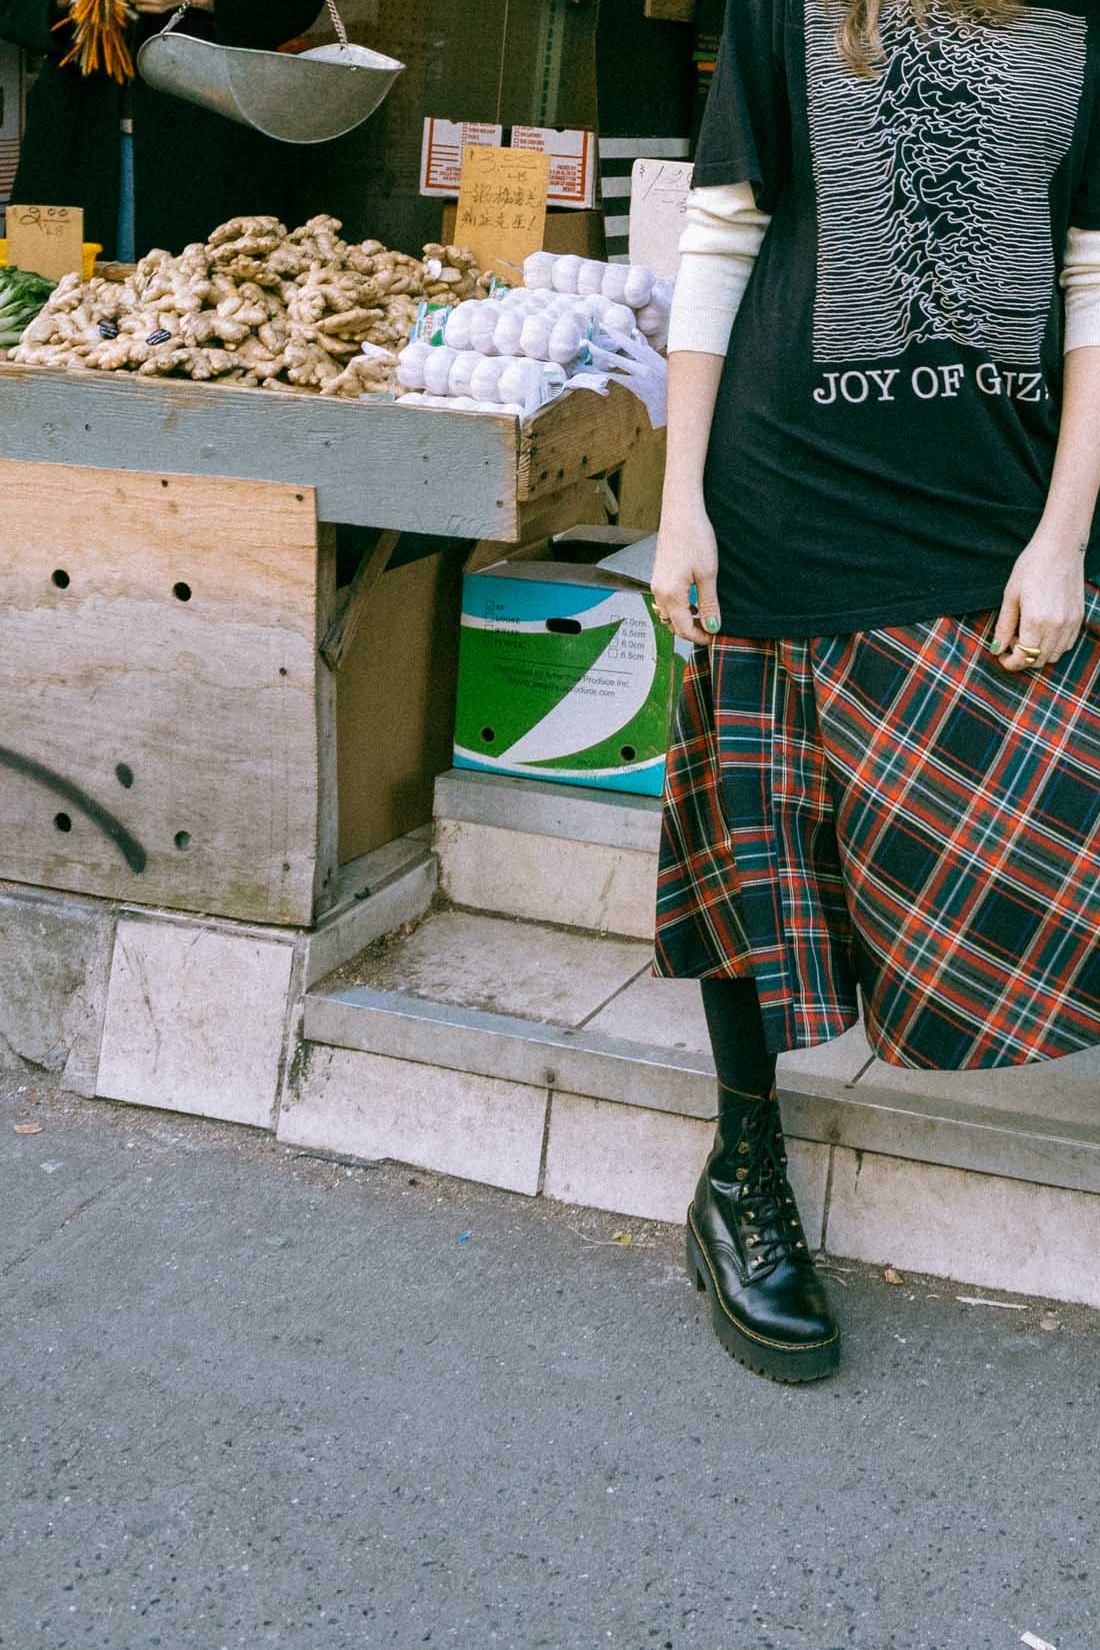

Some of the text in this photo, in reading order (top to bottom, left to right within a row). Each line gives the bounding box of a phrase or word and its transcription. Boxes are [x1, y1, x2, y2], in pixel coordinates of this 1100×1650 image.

[812, 362, 1050, 405] JOY OF GIZ
